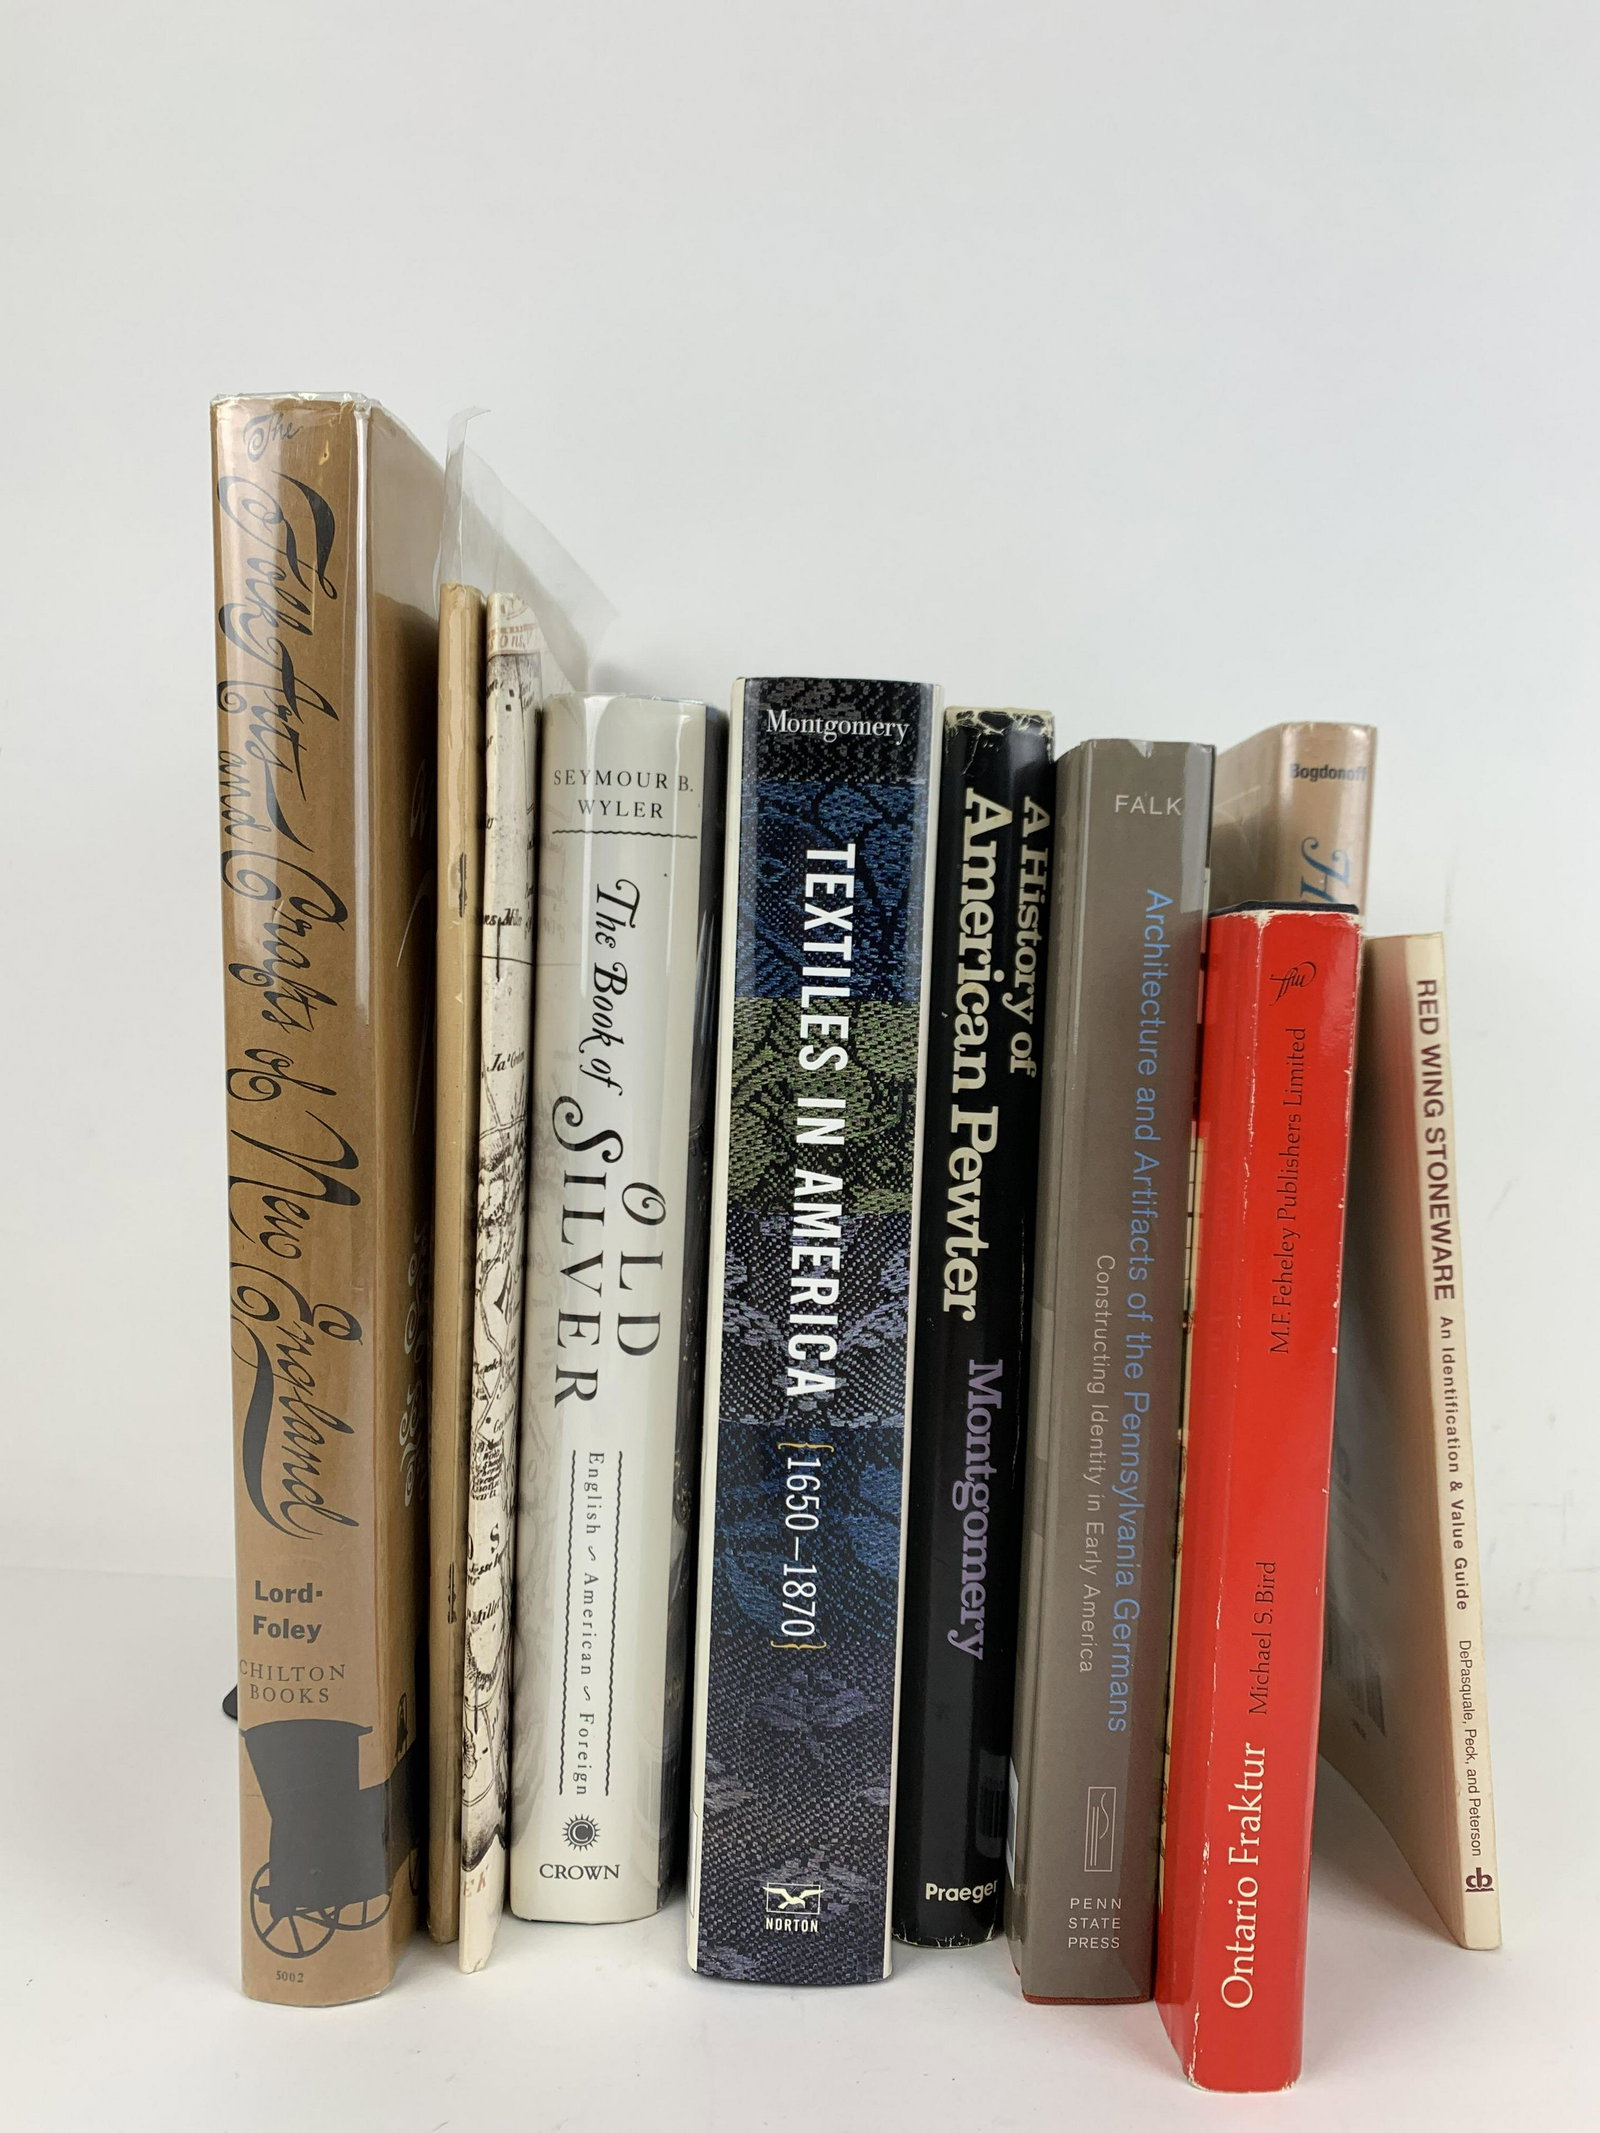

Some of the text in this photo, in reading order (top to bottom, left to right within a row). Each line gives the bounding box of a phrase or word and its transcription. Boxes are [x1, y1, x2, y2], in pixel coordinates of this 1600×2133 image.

[243, 412, 303, 462] The
[766, 708, 909, 746] Montgomery
[553, 769, 693, 792] SEYMOUR B.
[578, 799, 663, 819] WYLER
[1115, 794, 1182, 816] FALK
[1291, 763, 1367, 782] Bogdonoff
[1002, 796, 1050, 1078] A History of
[217, 470, 363, 1541] Folk Arts and Crafts of New England
[578, 878, 640, 1097] The Book of
[943, 787, 1013, 1322] American Pewter
[1283, 1028, 1306, 1105] Limited
[786, 843, 856, 1396] TEXTILES IN AMERICA
[1276, 1114, 1302, 1221] Publishers
[552, 1095, 624, 1408] SILVER
[617, 1182, 667, 1356] OLD
[1272, 1227, 1301, 1306] Feheley
[1108, 888, 1174, 1732] Architecture and Artifacts of the Pennsylvania Germans
[1269, 1312, 1291, 1354] M.F.
[1416, 980, 1481, 1857] RED WING STONEWARE An Identification & Value Guide DePasquale, Peck, and Peterson
[1079, 1255, 1116, 1673] Constructing Identity in Early America
[947, 1359, 1003, 1660] Montgomery
[253, 1614, 322, 1644] Foley
[573, 1452, 605, 1795] English American Foreign
[1249, 1562, 1276, 1715] Michael S. Bird
[239, 1659, 346, 1682] CHILTON
[250, 1683, 330, 1704] BOOKS
[539, 1863, 620, 1880] CROWN
[925, 1880, 998, 1904] Praeger
[1070, 1898, 1122, 1910] PENN
[1221, 1742, 1266, 2009] Ontario Fraktur
[766, 1917, 818, 1933] NORTON
[1068, 1917, 1121, 1930] STATE
[1068, 1937, 1120, 1949] PRESS
